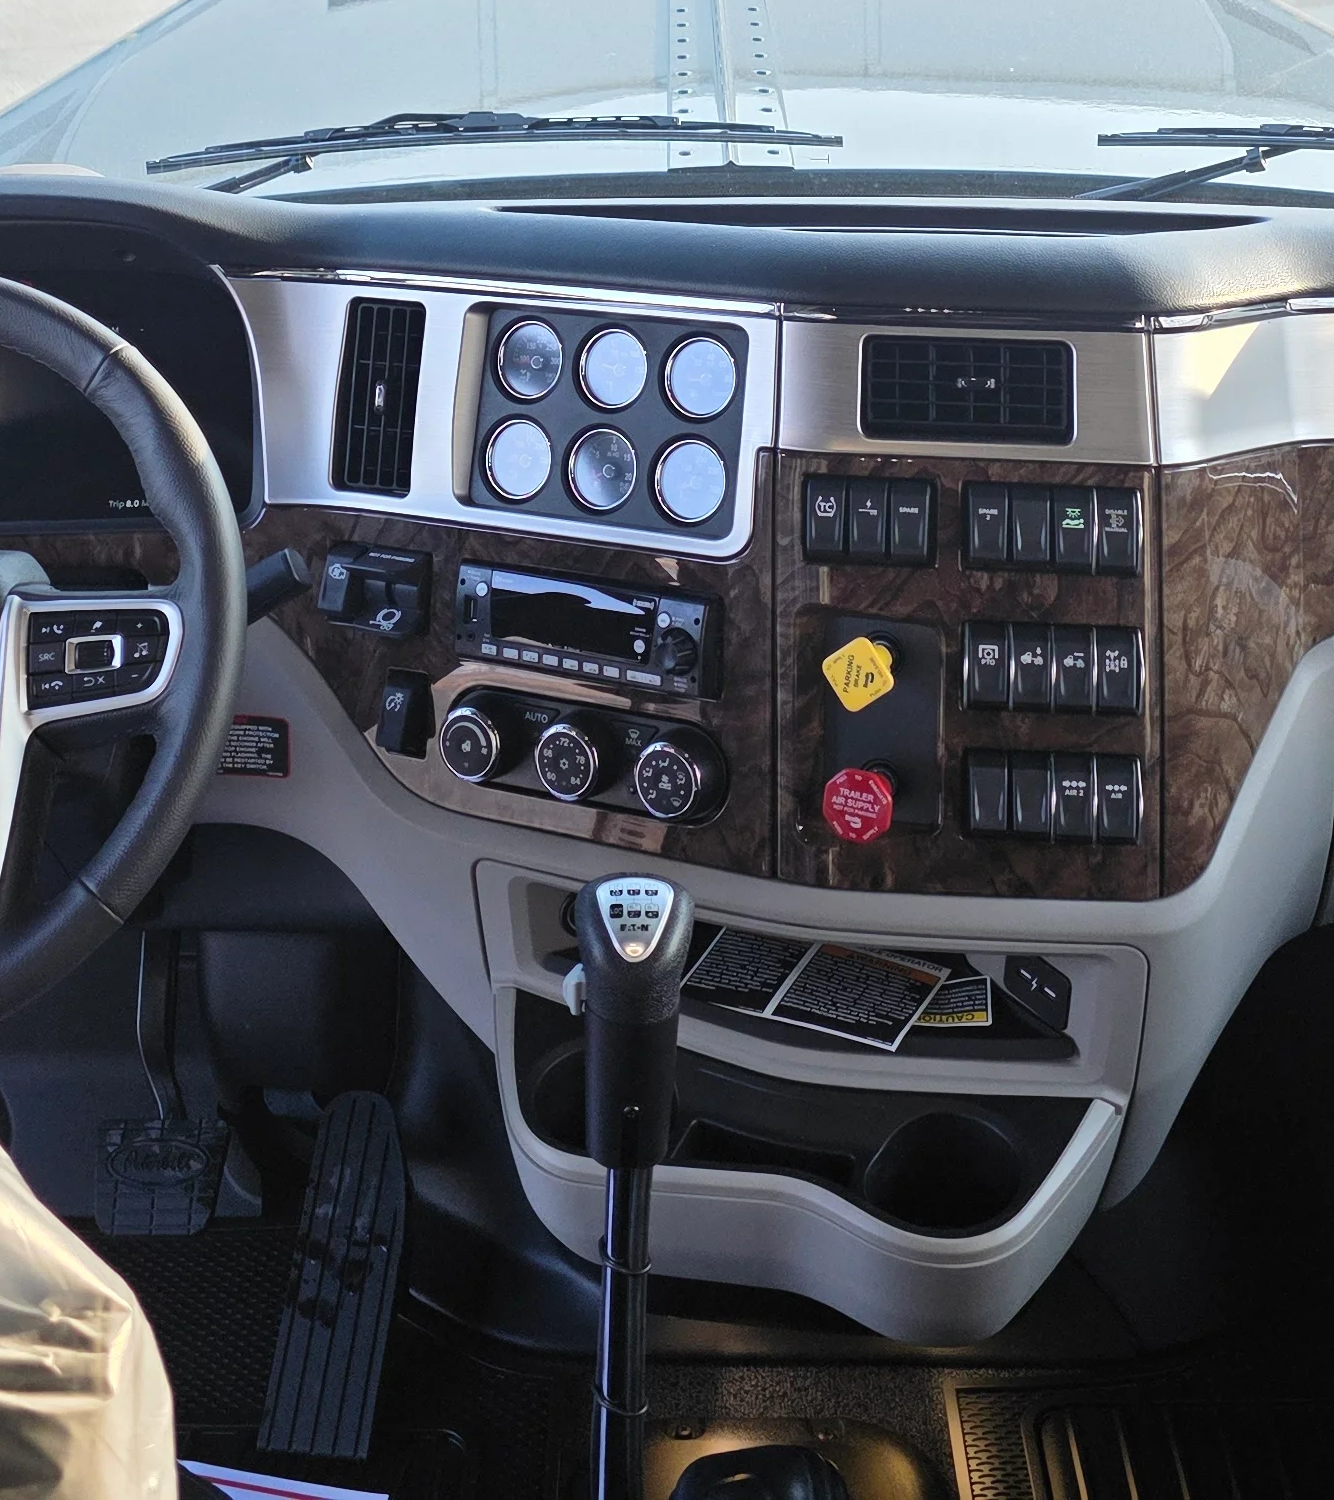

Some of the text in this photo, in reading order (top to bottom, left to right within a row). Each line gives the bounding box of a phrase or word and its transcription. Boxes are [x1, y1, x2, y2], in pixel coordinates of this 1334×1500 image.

[108, 500, 125, 509] Trip
[125, 499, 140, 508] 8.0
[818, 501, 833, 512] TC
[899, 506, 919, 514] SPARE
[38, 651, 56, 662] SRC
[981, 658, 996, 666] PTO
[842, 654, 855, 694] PARKING
[853, 664, 863, 688] BRAKE
[524, 711, 549, 724] AUTO
[559, 737, 570, 747] 72
[625, 737, 642, 748] MAX
[576, 755, 586, 765] 78
[546, 771, 557, 781] 60
[570, 776, 581, 786] 84
[839, 787, 875, 803] TRAILER
[831, 795, 881, 813] AIR SUPPLY
[856, 954, 912, 976] WARNING
[886, 952, 943, 973] OPERATOR
